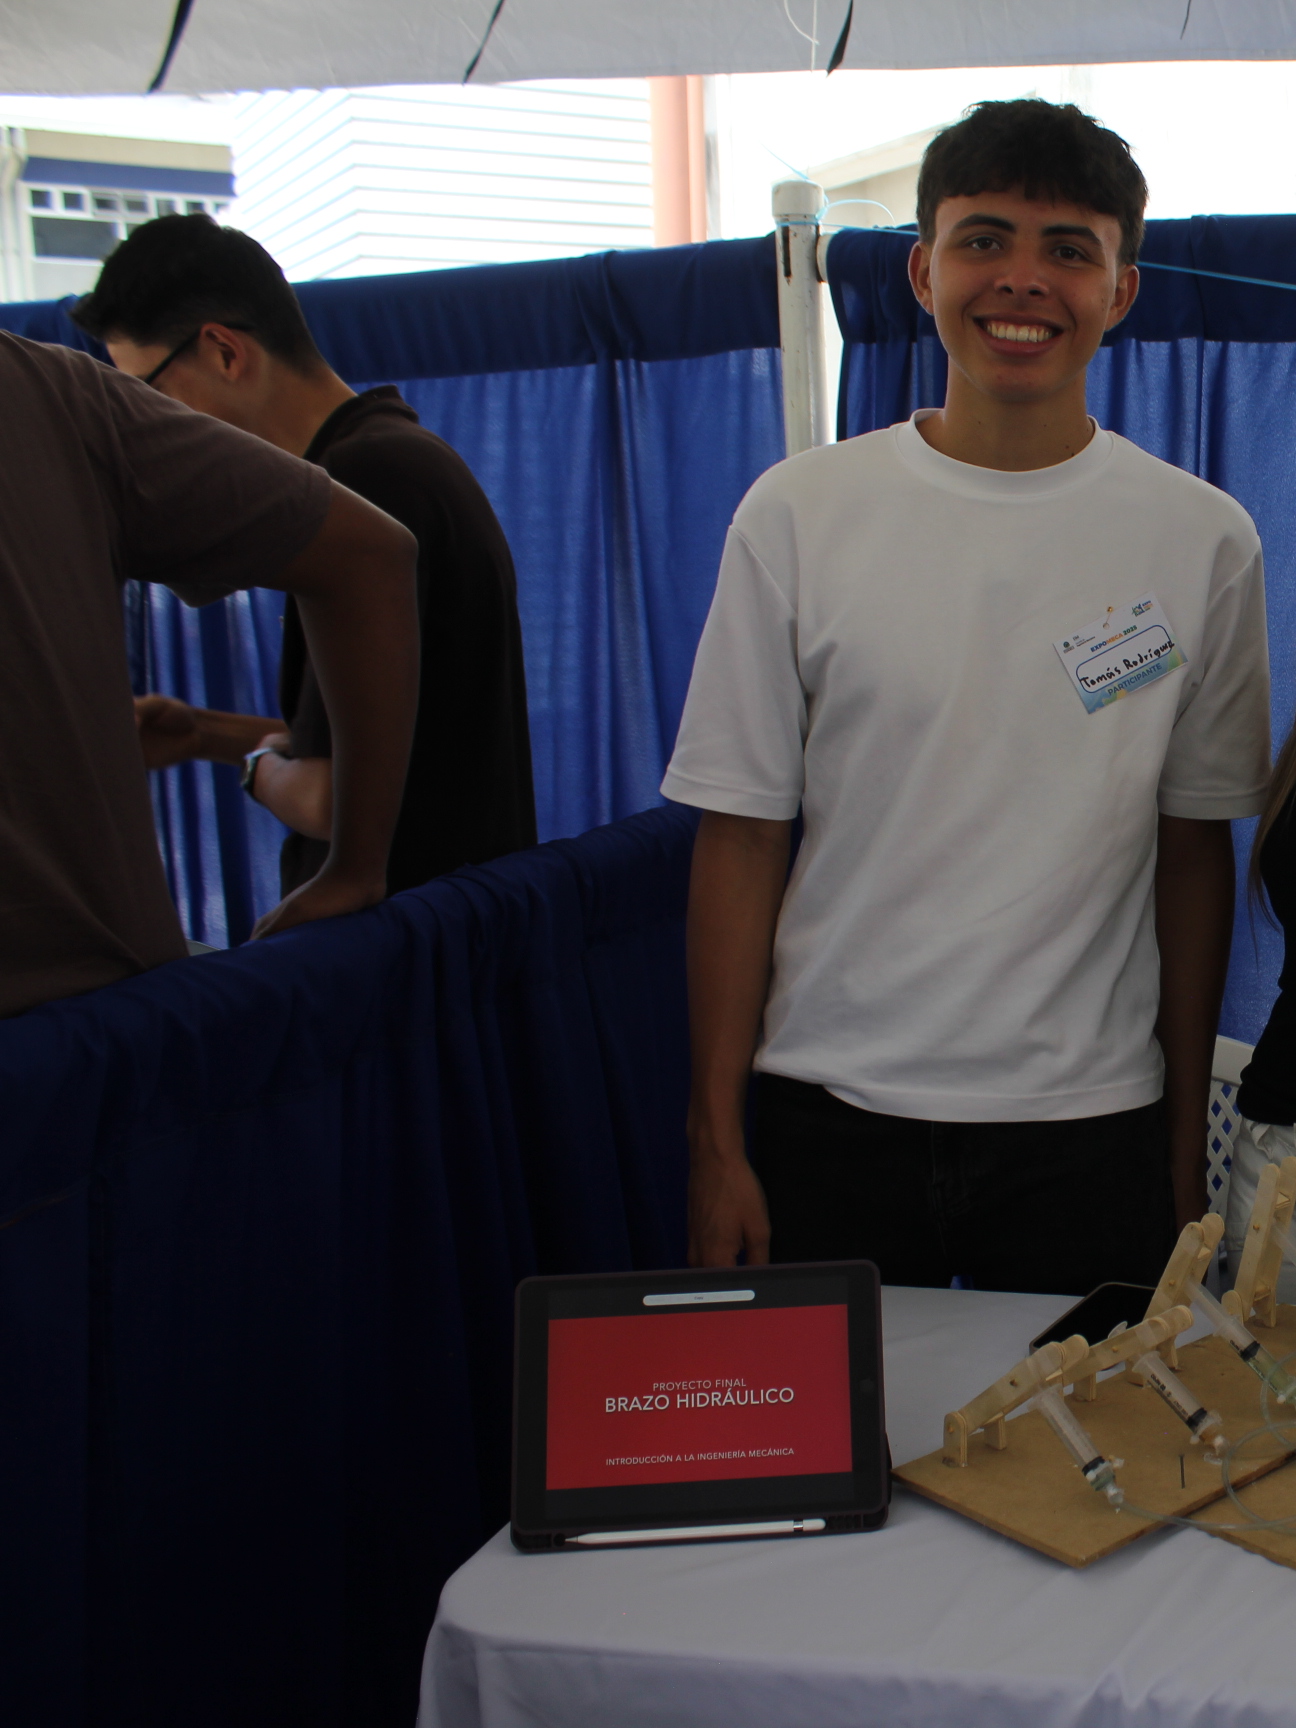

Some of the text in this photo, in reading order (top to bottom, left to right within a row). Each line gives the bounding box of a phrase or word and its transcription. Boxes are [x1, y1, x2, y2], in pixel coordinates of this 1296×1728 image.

[1080, 667, 1122, 688] Tomás
[1107, 662, 1163, 696] PARTICIPANTE
[652, 1377, 747, 1392] PROYECTO FINAL
[605, 1387, 795, 1413] BRAZO HIDRÁULICO
[605, 1446, 795, 1467] INTRODUCCIÓN A LA INGENIERÍA MECÁNICA
